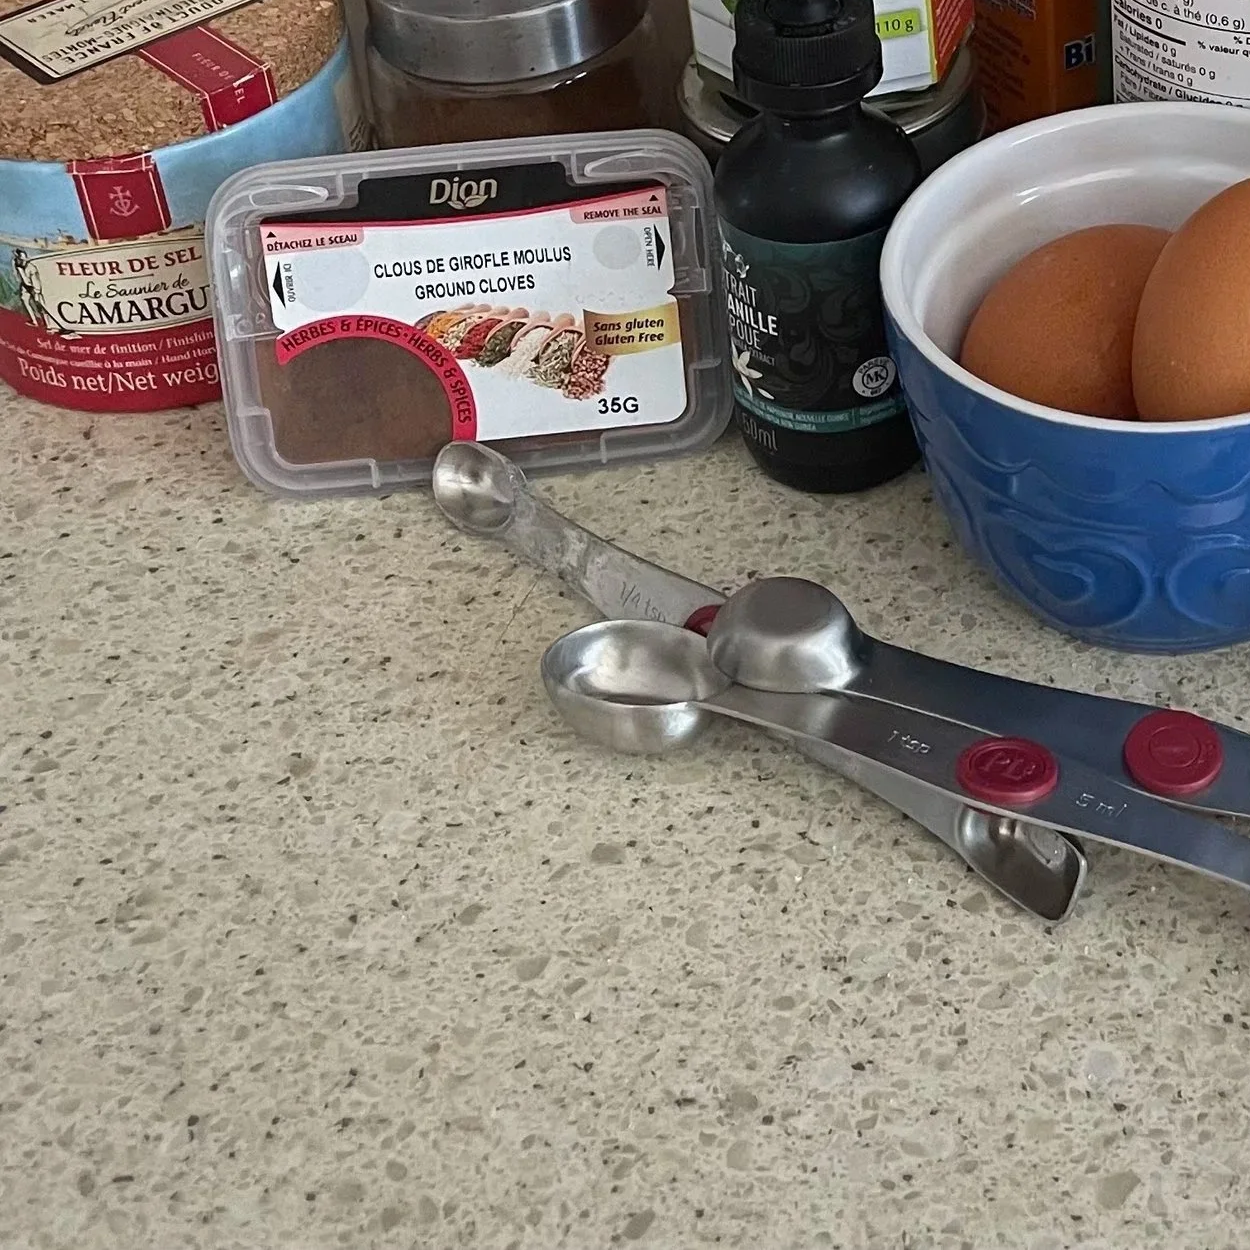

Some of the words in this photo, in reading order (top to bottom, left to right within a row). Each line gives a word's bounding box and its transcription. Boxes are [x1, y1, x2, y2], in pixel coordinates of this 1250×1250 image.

[905, 18, 914, 31] g
[1155, 17, 1163, 29] 0
[1173, 4, 1181, 16] à
[1183, 8, 1202, 21] thé
[1233, 18, 1246, 30] g)
[64, 32, 137, 65] FRANCE
[1129, 26, 1160, 49] Lipides
[1162, 43, 1169, 53] 0
[1170, 47, 1177, 58] g
[1198, 40, 1206, 49] %
[1209, 44, 1240, 55] valeur
[1233, 36, 1243, 45] %
[1114, 54, 1167, 93] Carbohydrate
[1152, 61, 1175, 80] trans
[1177, 73, 1184, 82] 0
[1186, 77, 1193, 87] g
[1161, 56, 1197, 74] saturés
[1199, 66, 1206, 76] 0
[1208, 70, 1216, 81] g
[430, 177, 498, 207] Dion
[583, 208, 620, 220] REMOVE
[622, 207, 639, 216] THE
[641, 206, 662, 215] SEAL
[267, 238, 313, 251] DÉTACHEZ
[315, 237, 325, 246] LE
[328, 234, 358, 245] SCEAU
[57, 261, 121, 278] FLEUR
[127, 256, 160, 272] DE
[165, 246, 202, 267] SEL
[374, 260, 422, 279] CLOUS
[426, 258, 445, 273] DE
[449, 251, 510, 271] GIROFLE
[514, 246, 572, 265] MOULUS
[79, 280, 100, 299] Le
[106, 280, 170, 298] Saunier
[172, 272, 190, 289] de
[415, 281, 476, 300] GROUND
[479, 274, 535, 293] CLOVES
[723, 268, 757, 308] TRAIT
[57, 285, 213, 328] CAMARGU
[727, 293, 778, 337] ANILLE
[593, 321, 621, 333] Sans
[625, 316, 664, 331] gluten
[70, 345, 91, 354] mer
[94, 344, 107, 354] de
[110, 342, 157, 354] finition
[166, 330, 215, 349] Finishin
[595, 333, 635, 345] Gluten
[638, 332, 665, 343] Free
[125, 359, 153, 368] main
[161, 351, 191, 363] Hand
[281, 320, 336, 352] HERBES
[340, 320, 352, 332] &
[356, 316, 402, 338] ÉPICES
[407, 332, 449, 368] HERBS
[443, 367, 457, 379] &
[450, 380, 472, 424] SPICES
[17, 357, 68, 388] Poids
[71, 371, 158, 395] net/Net
[163, 362, 220, 387] weig
[598, 396, 640, 415] 35G
